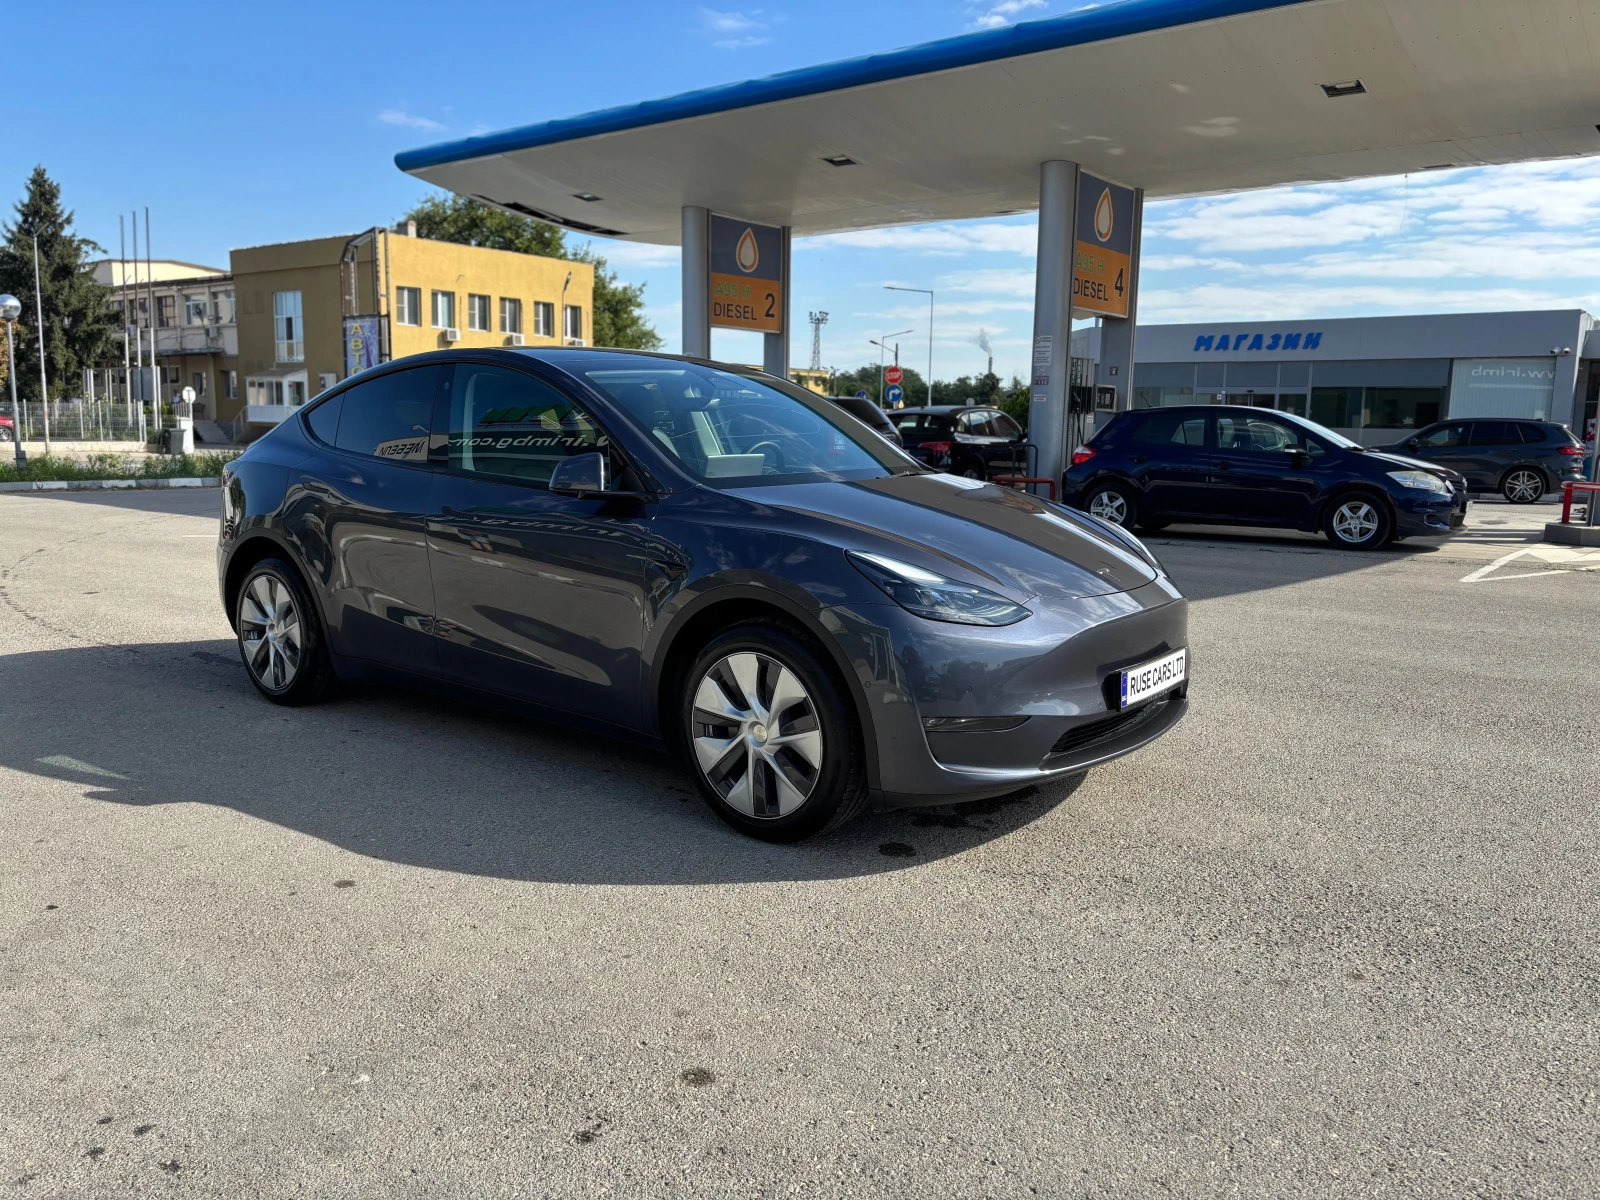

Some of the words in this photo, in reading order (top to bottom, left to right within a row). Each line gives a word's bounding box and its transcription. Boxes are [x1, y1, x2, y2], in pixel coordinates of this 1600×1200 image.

[1075, 251, 1095, 274] A95
[714, 281, 738, 298] A95
[741, 284, 751, 299] H
[1073, 277, 1109, 301] DIESEL
[1115, 267, 1124, 298] 4
[713, 301, 757, 320] DIESEL
[764, 292, 776, 318] 2
[1193, 332, 1323, 351] МАГАЗИН
[886, 372, 901, 380] STOP
[1130, 669, 1152, 696] RUSE
[1152, 661, 1172, 686] CARS
[1172, 655, 1184, 678] LTD
